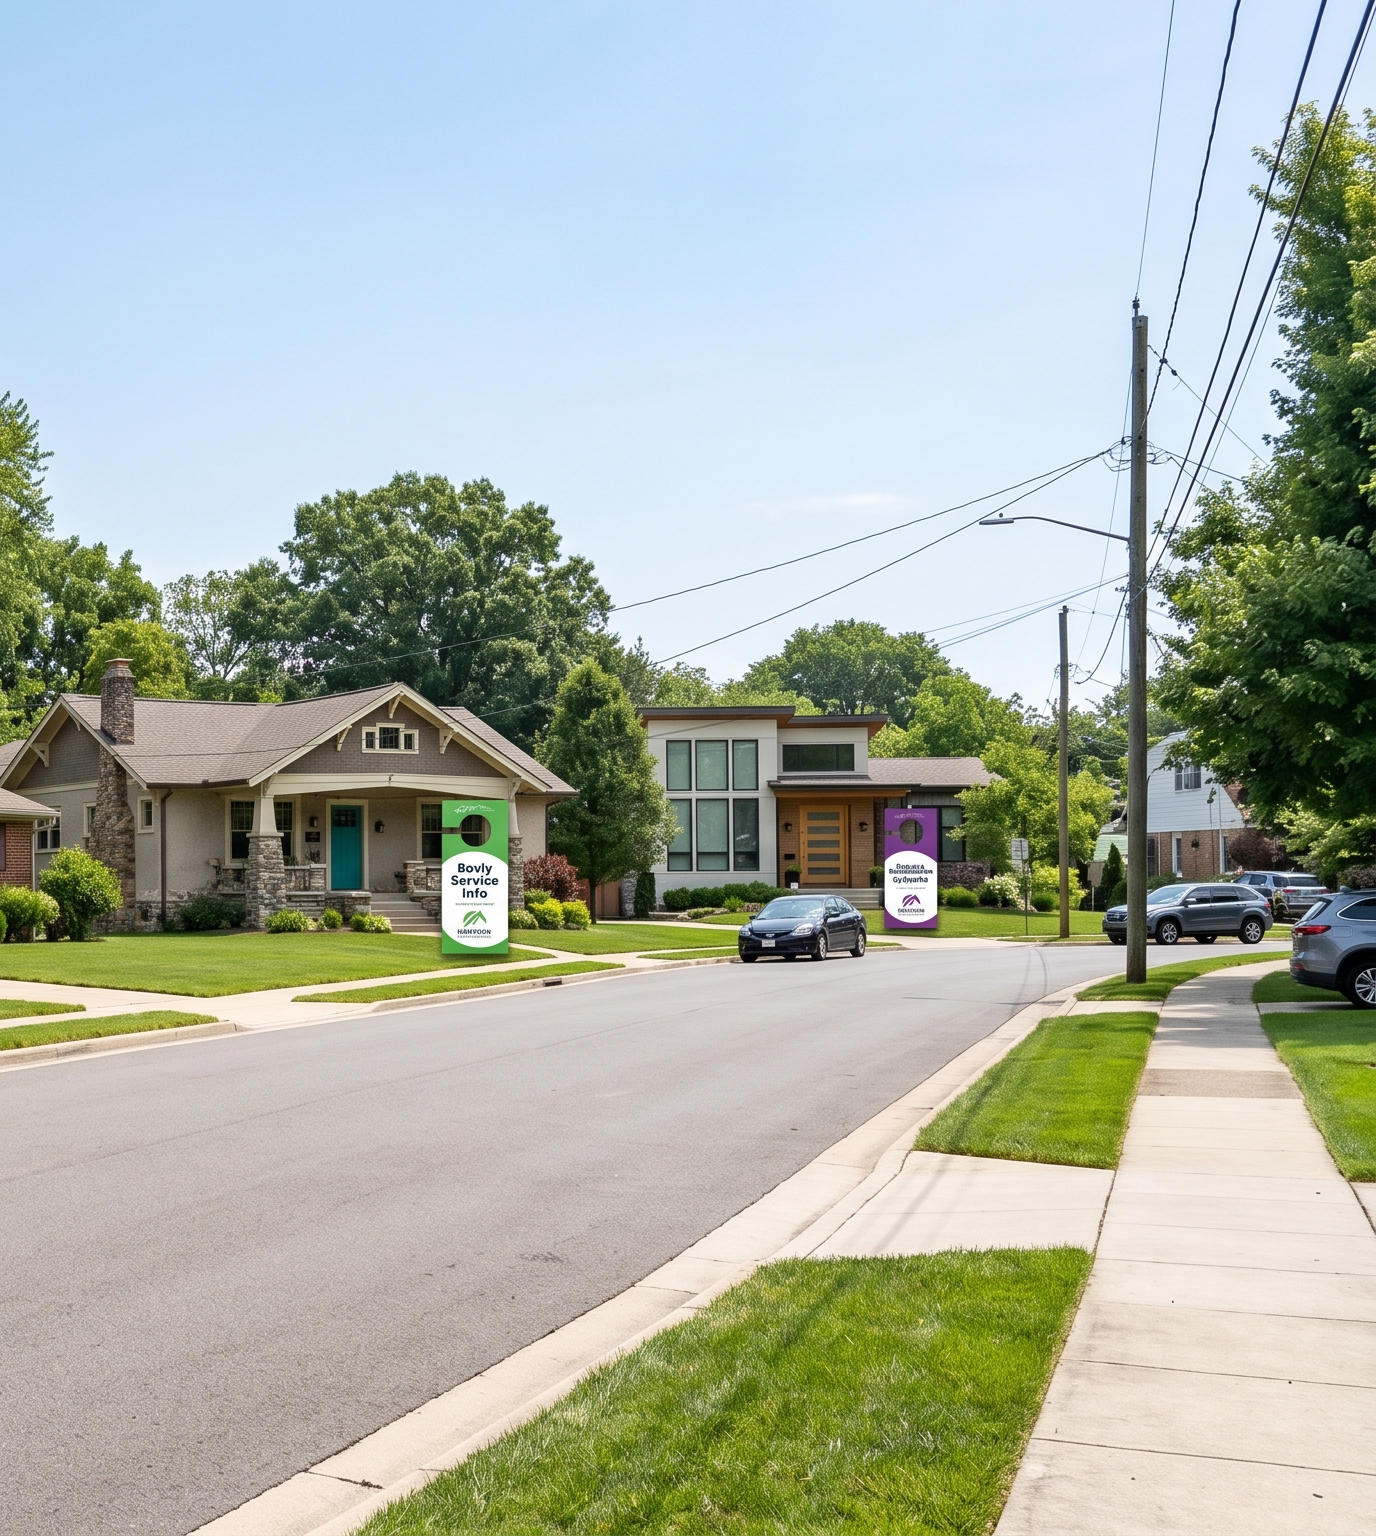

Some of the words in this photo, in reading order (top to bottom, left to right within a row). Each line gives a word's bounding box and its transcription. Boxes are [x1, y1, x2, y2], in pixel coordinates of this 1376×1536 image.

[458, 863, 492, 876] Bovly
[451, 875, 498, 885] Service
[462, 888, 488, 898] Info
